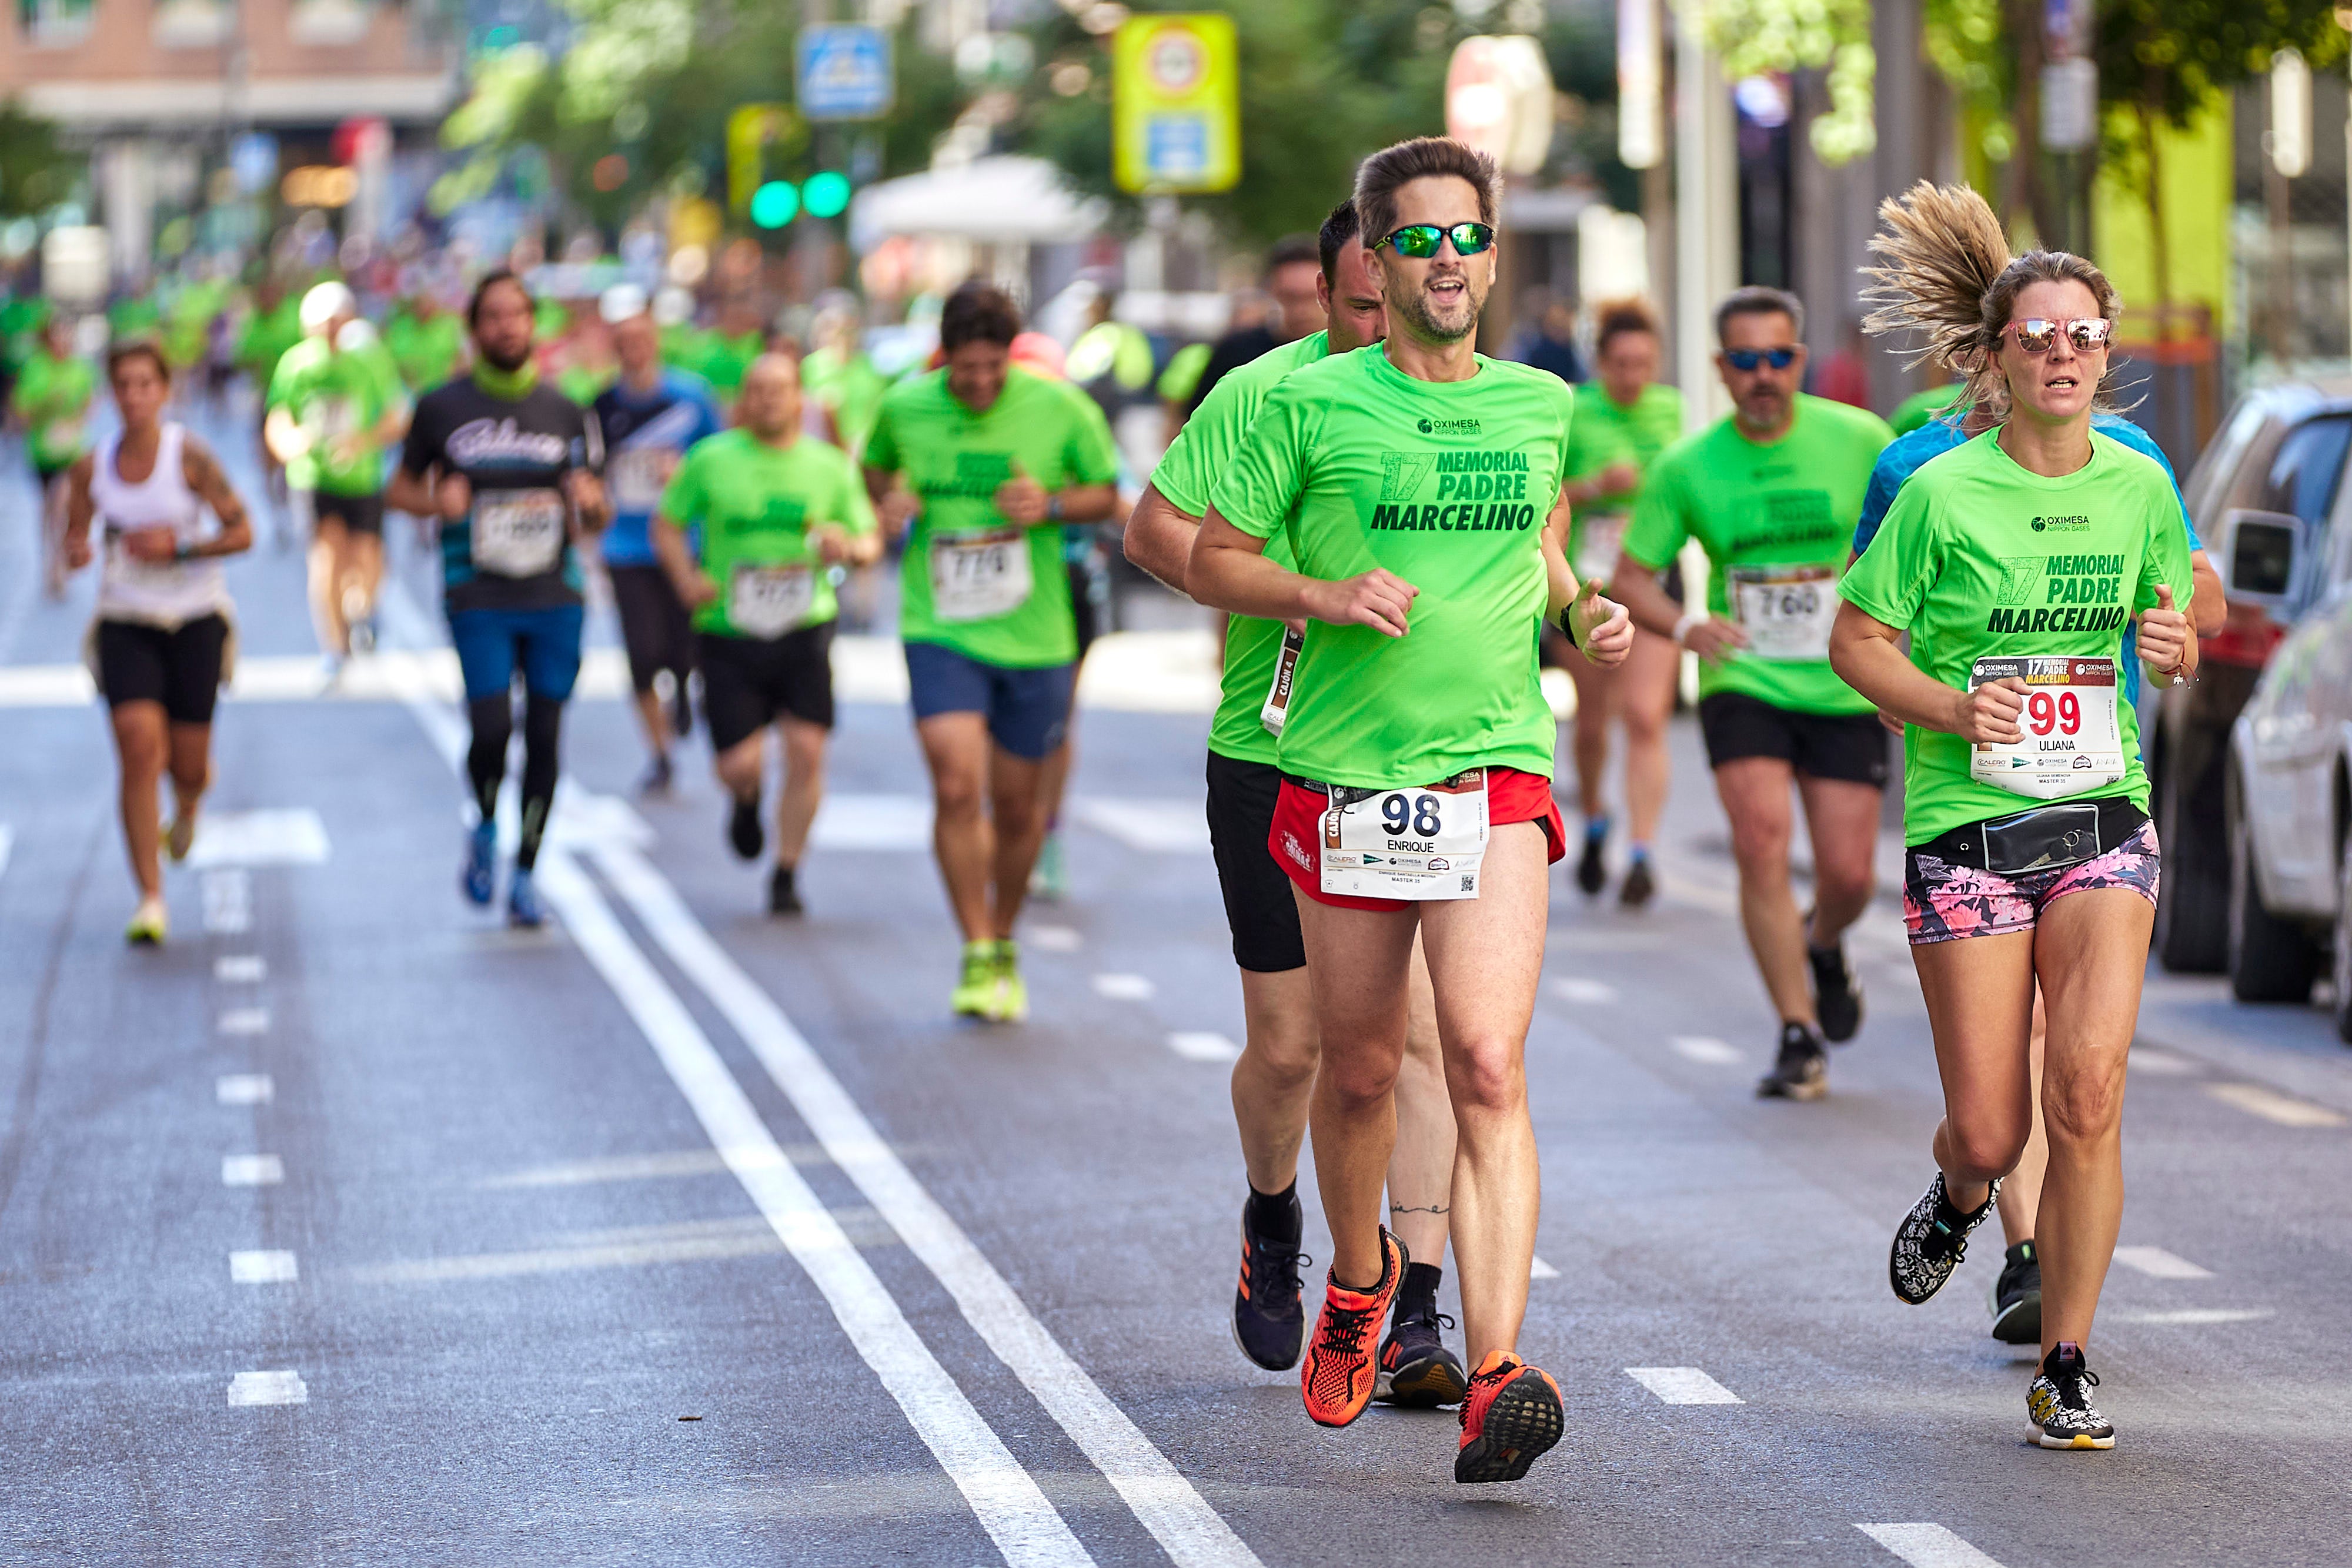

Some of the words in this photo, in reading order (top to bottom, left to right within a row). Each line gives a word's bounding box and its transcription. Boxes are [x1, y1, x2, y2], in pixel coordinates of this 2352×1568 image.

[1434, 419, 1481, 428] OXIMESA
[1380, 452, 1436, 500] 17
[1435, 452, 1529, 472] MEMORIAL
[1436, 474, 1527, 500] PADRE
[1371, 503, 1534, 530] MARCELINO
[2047, 516, 2089, 524] OXIMESA
[1997, 556, 2047, 605] 17
[2046, 554, 2124, 575] MEMORIAL
[2047, 577, 2120, 603] PADRE
[1987, 606, 2124, 633] MARCELINO
[2026, 674, 2070, 684] MARCELINO
[2027, 659, 2043, 675] 17
[2043, 665, 2068, 674] PADRE
[1279, 668, 1292, 696] CAJÓN
[2029, 691, 2081, 735] 99
[2039, 740, 2075, 751] ULIANA
[1381, 793, 1441, 837] 98
[1388, 840, 1434, 852] ENRIQUE
